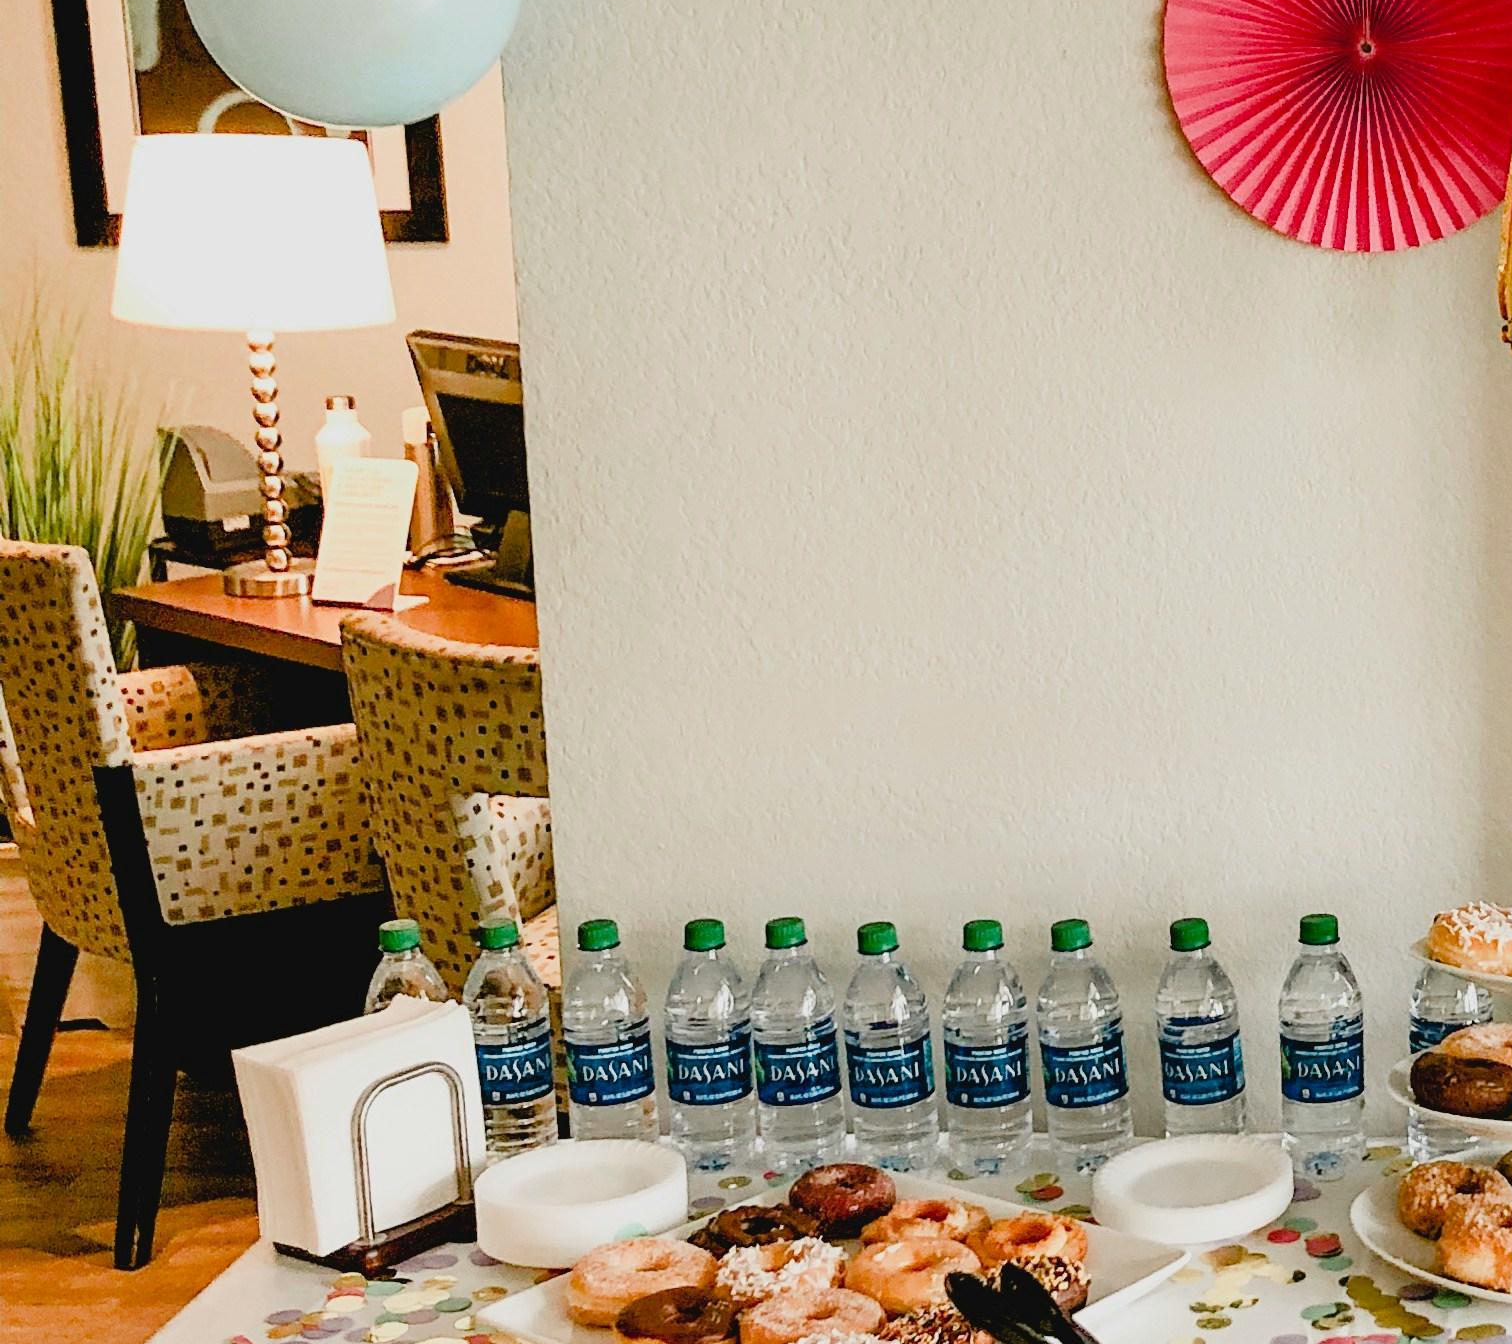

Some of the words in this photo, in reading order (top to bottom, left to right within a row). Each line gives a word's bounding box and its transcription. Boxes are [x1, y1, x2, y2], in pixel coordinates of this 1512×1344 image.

[486, 1053, 551, 1083] DASANI
[583, 1055, 648, 1083] DASANI
[679, 1058, 744, 1085] DASANI
[771, 1056, 835, 1084] DASANI
[855, 1062, 920, 1087] DASANI
[956, 1061, 1022, 1087] DASANI
[1055, 1058, 1120, 1086] DASANI
[1165, 1059, 1229, 1083] DASANI
[1297, 1055, 1360, 1080] DASANI
